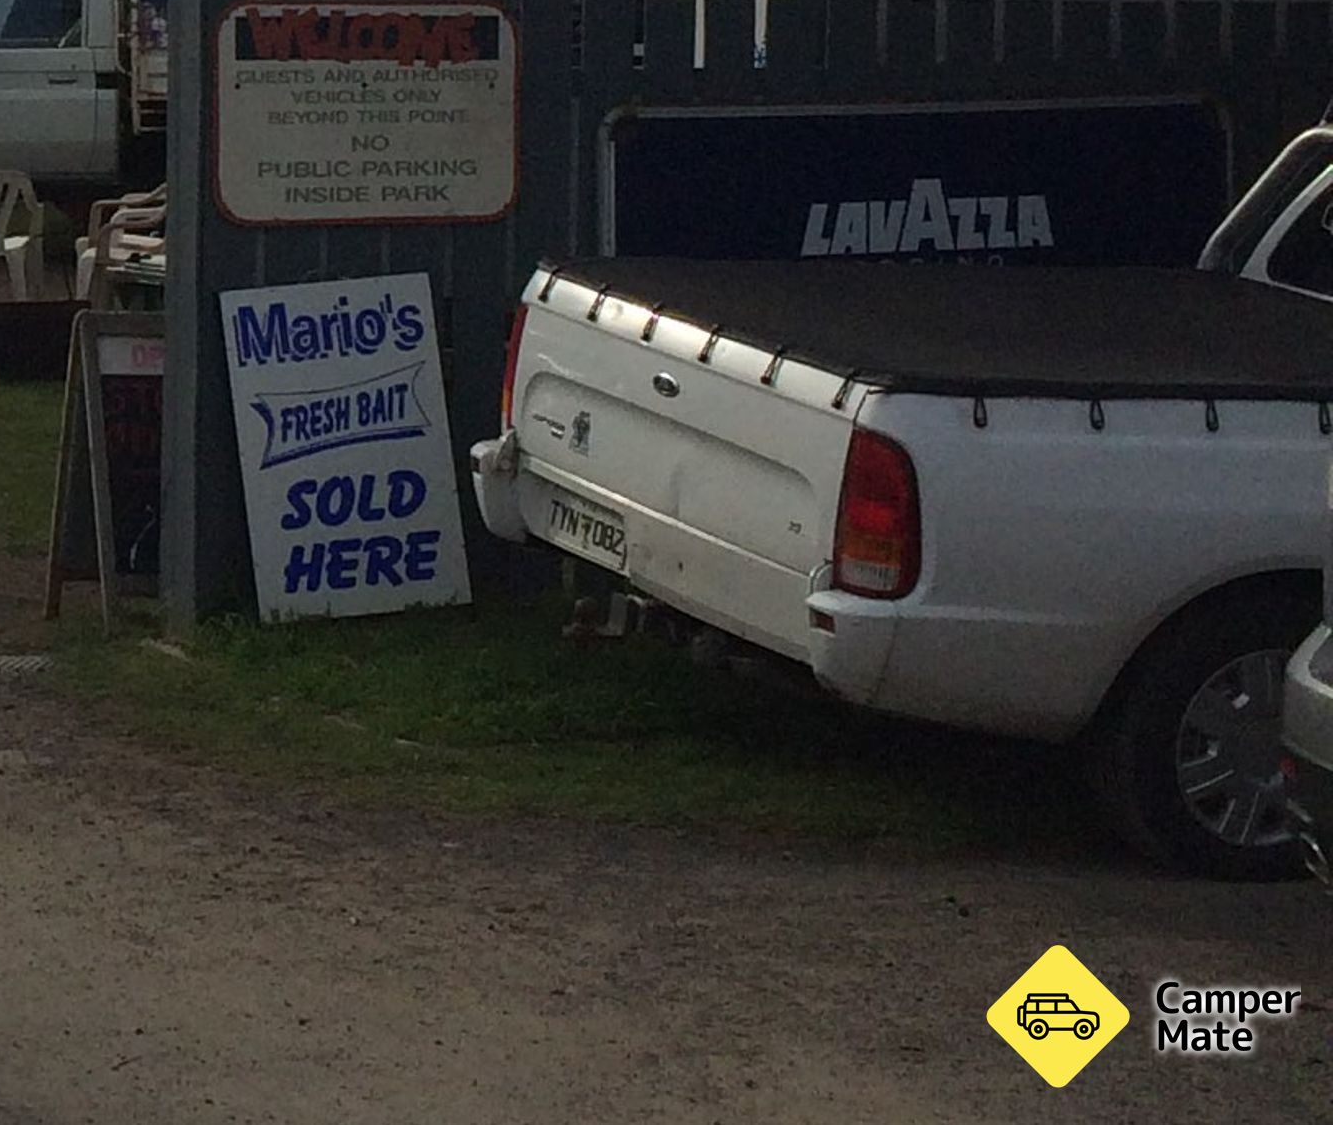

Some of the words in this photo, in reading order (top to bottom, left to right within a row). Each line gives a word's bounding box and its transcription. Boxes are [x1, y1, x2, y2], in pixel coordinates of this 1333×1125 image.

[236, 70, 315, 84] GUESTS
[324, 69, 366, 83] AND
[372, 68, 499, 82] AUTHORISED
[290, 90, 384, 104] VEHICLES
[392, 89, 442, 103] ONLY
[268, 111, 349, 125] BEYOND
[356, 110, 401, 124] THIS
[408, 109, 469, 124] POINT
[351, 135, 390, 152] NO
[257, 161, 352, 179] PUBLIC
[360, 159, 478, 177] PARKING
[284, 186, 370, 203] INSIDE
[381, 185, 451, 202] PARK
[800, 177, 1055, 257] LAVAZZA
[234, 293, 425, 367] Mario's
[280, 398, 350, 443] FRESH
[358, 383, 409, 427] BAIT
[281, 470, 427, 531] SOLD
[284, 530, 441, 594] HERE
